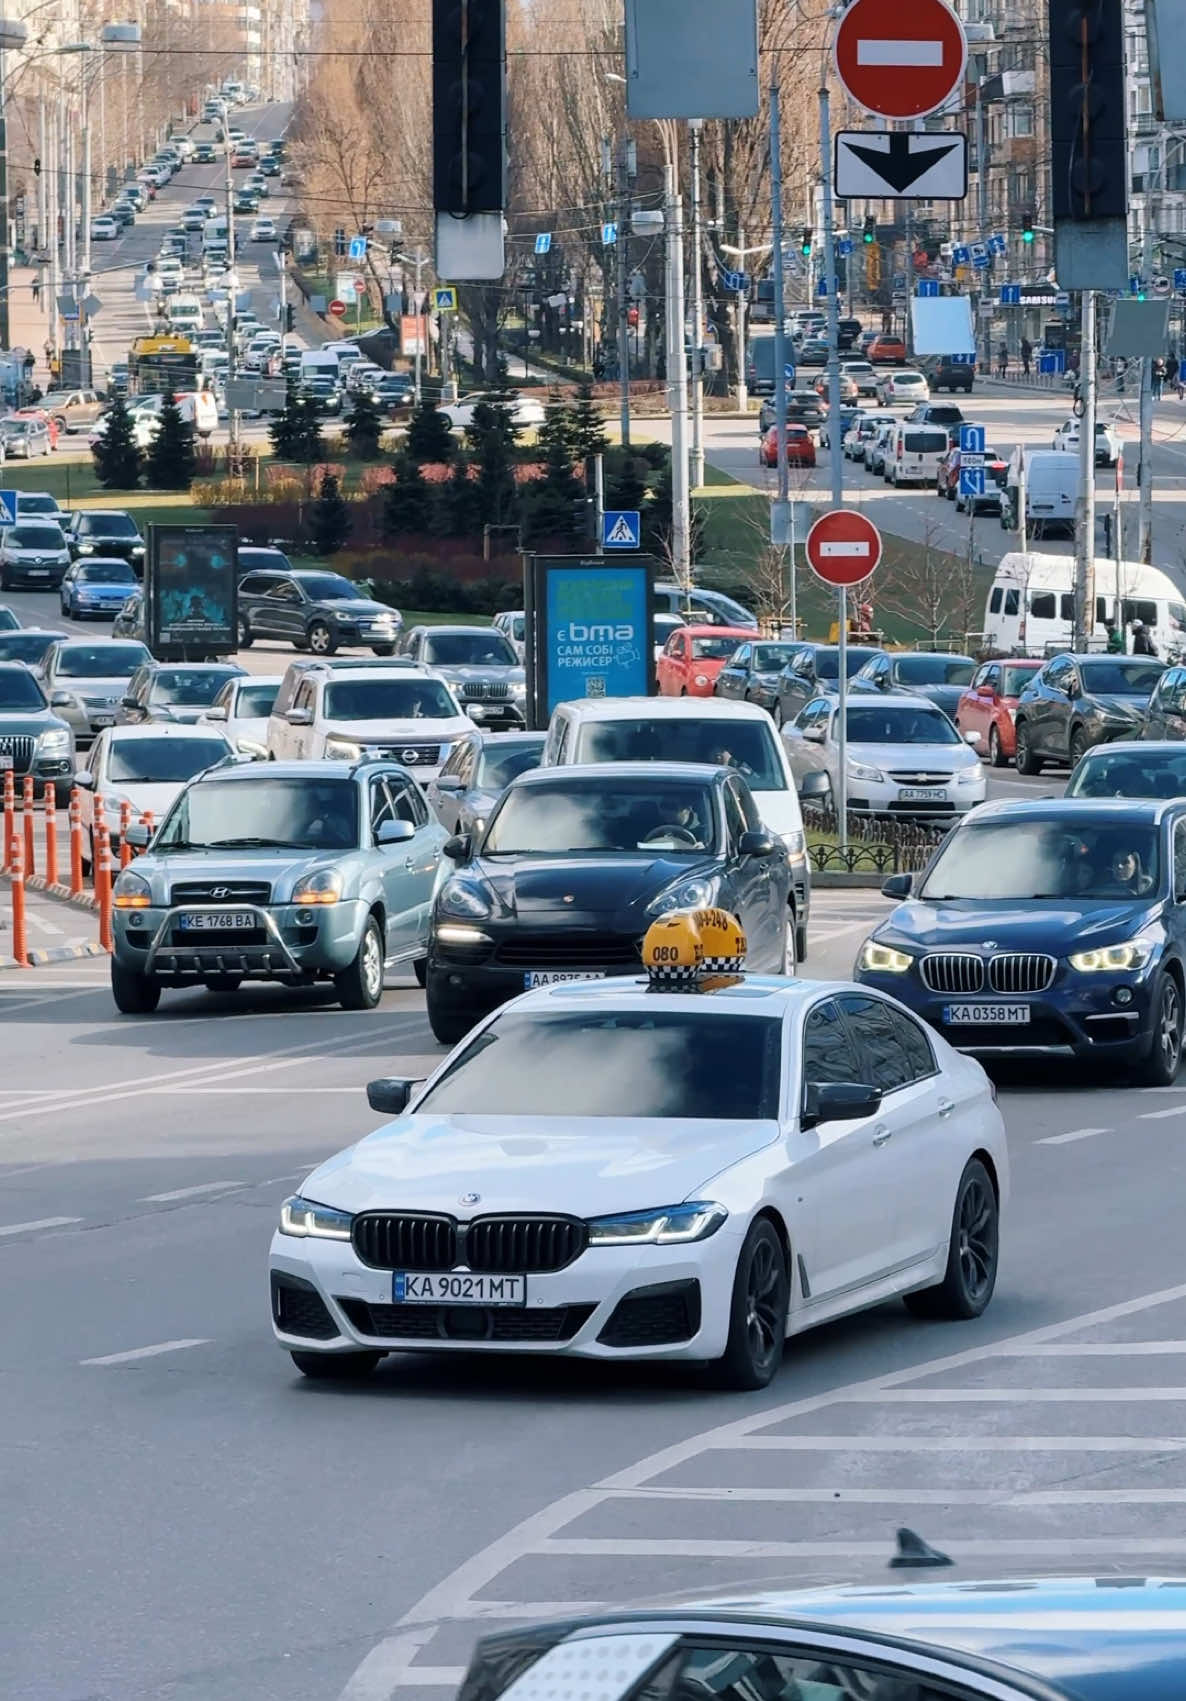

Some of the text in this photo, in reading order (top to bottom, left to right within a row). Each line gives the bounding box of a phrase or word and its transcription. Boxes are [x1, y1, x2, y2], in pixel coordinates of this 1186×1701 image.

[569, 622, 634, 642] bma
[557, 645, 613, 656] САМ СОБІ
[558, 656, 612, 668] РЕЖИСЕР
[207, 915, 233, 927] 1768
[235, 915, 252, 927] BA
[652, 946, 679, 961] 080
[533, 974, 549, 986] AA
[951, 1007, 1029, 1020] KA 0358 MT
[405, 1276, 520, 1299] KA 9021 MT
